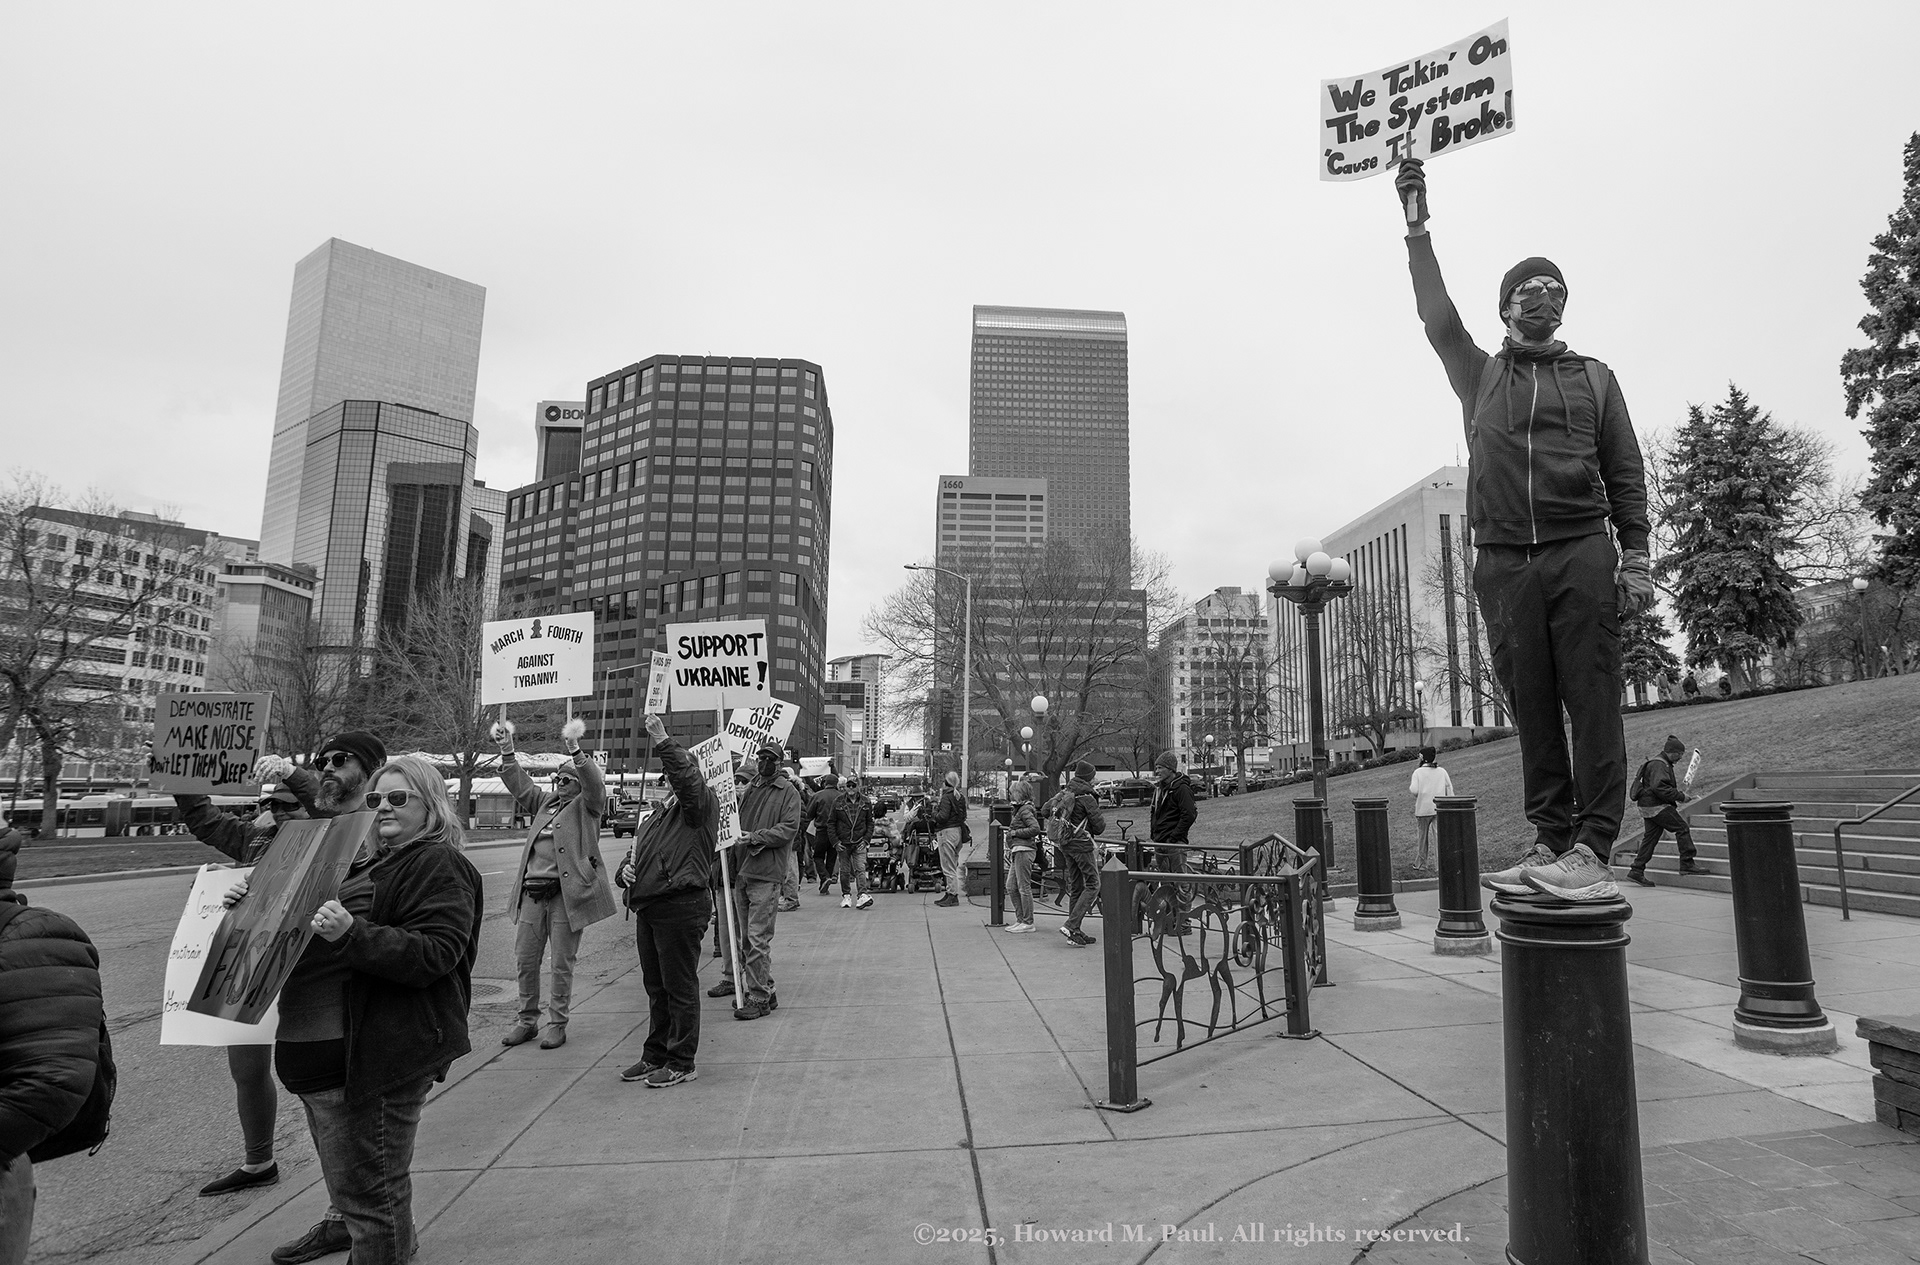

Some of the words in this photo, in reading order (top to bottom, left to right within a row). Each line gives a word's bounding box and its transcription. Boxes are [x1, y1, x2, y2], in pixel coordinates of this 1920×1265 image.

[1327, 79, 1376, 113] We
[1382, 51, 1457, 96] Takin'
[1468, 35, 1507, 66] On
[1325, 112, 1381, 144] The
[1387, 76, 1495, 130] System
[1324, 149, 1378, 175] 'Cause
[1385, 131, 1417, 171] It
[1430, 90, 1513, 154] Broke!
[943, 480, 963, 489] 1660
[490, 628, 525, 655] MARCH
[547, 625, 583, 644] FOURTH
[677, 633, 764, 660] SUPPORT
[517, 653, 555, 669] AGAINST
[513, 671, 558, 688] TYRANNY!
[170, 700, 255, 721] DEMONSTRATE
[749, 703, 783, 720] AVE
[749, 712, 774, 732] OUR
[163, 725, 208, 750] MAKE
[210, 724, 256, 750] NOISE
[171, 753, 190, 777] LET
[192, 753, 217, 778] THEM
[704, 756, 714, 768] IS
